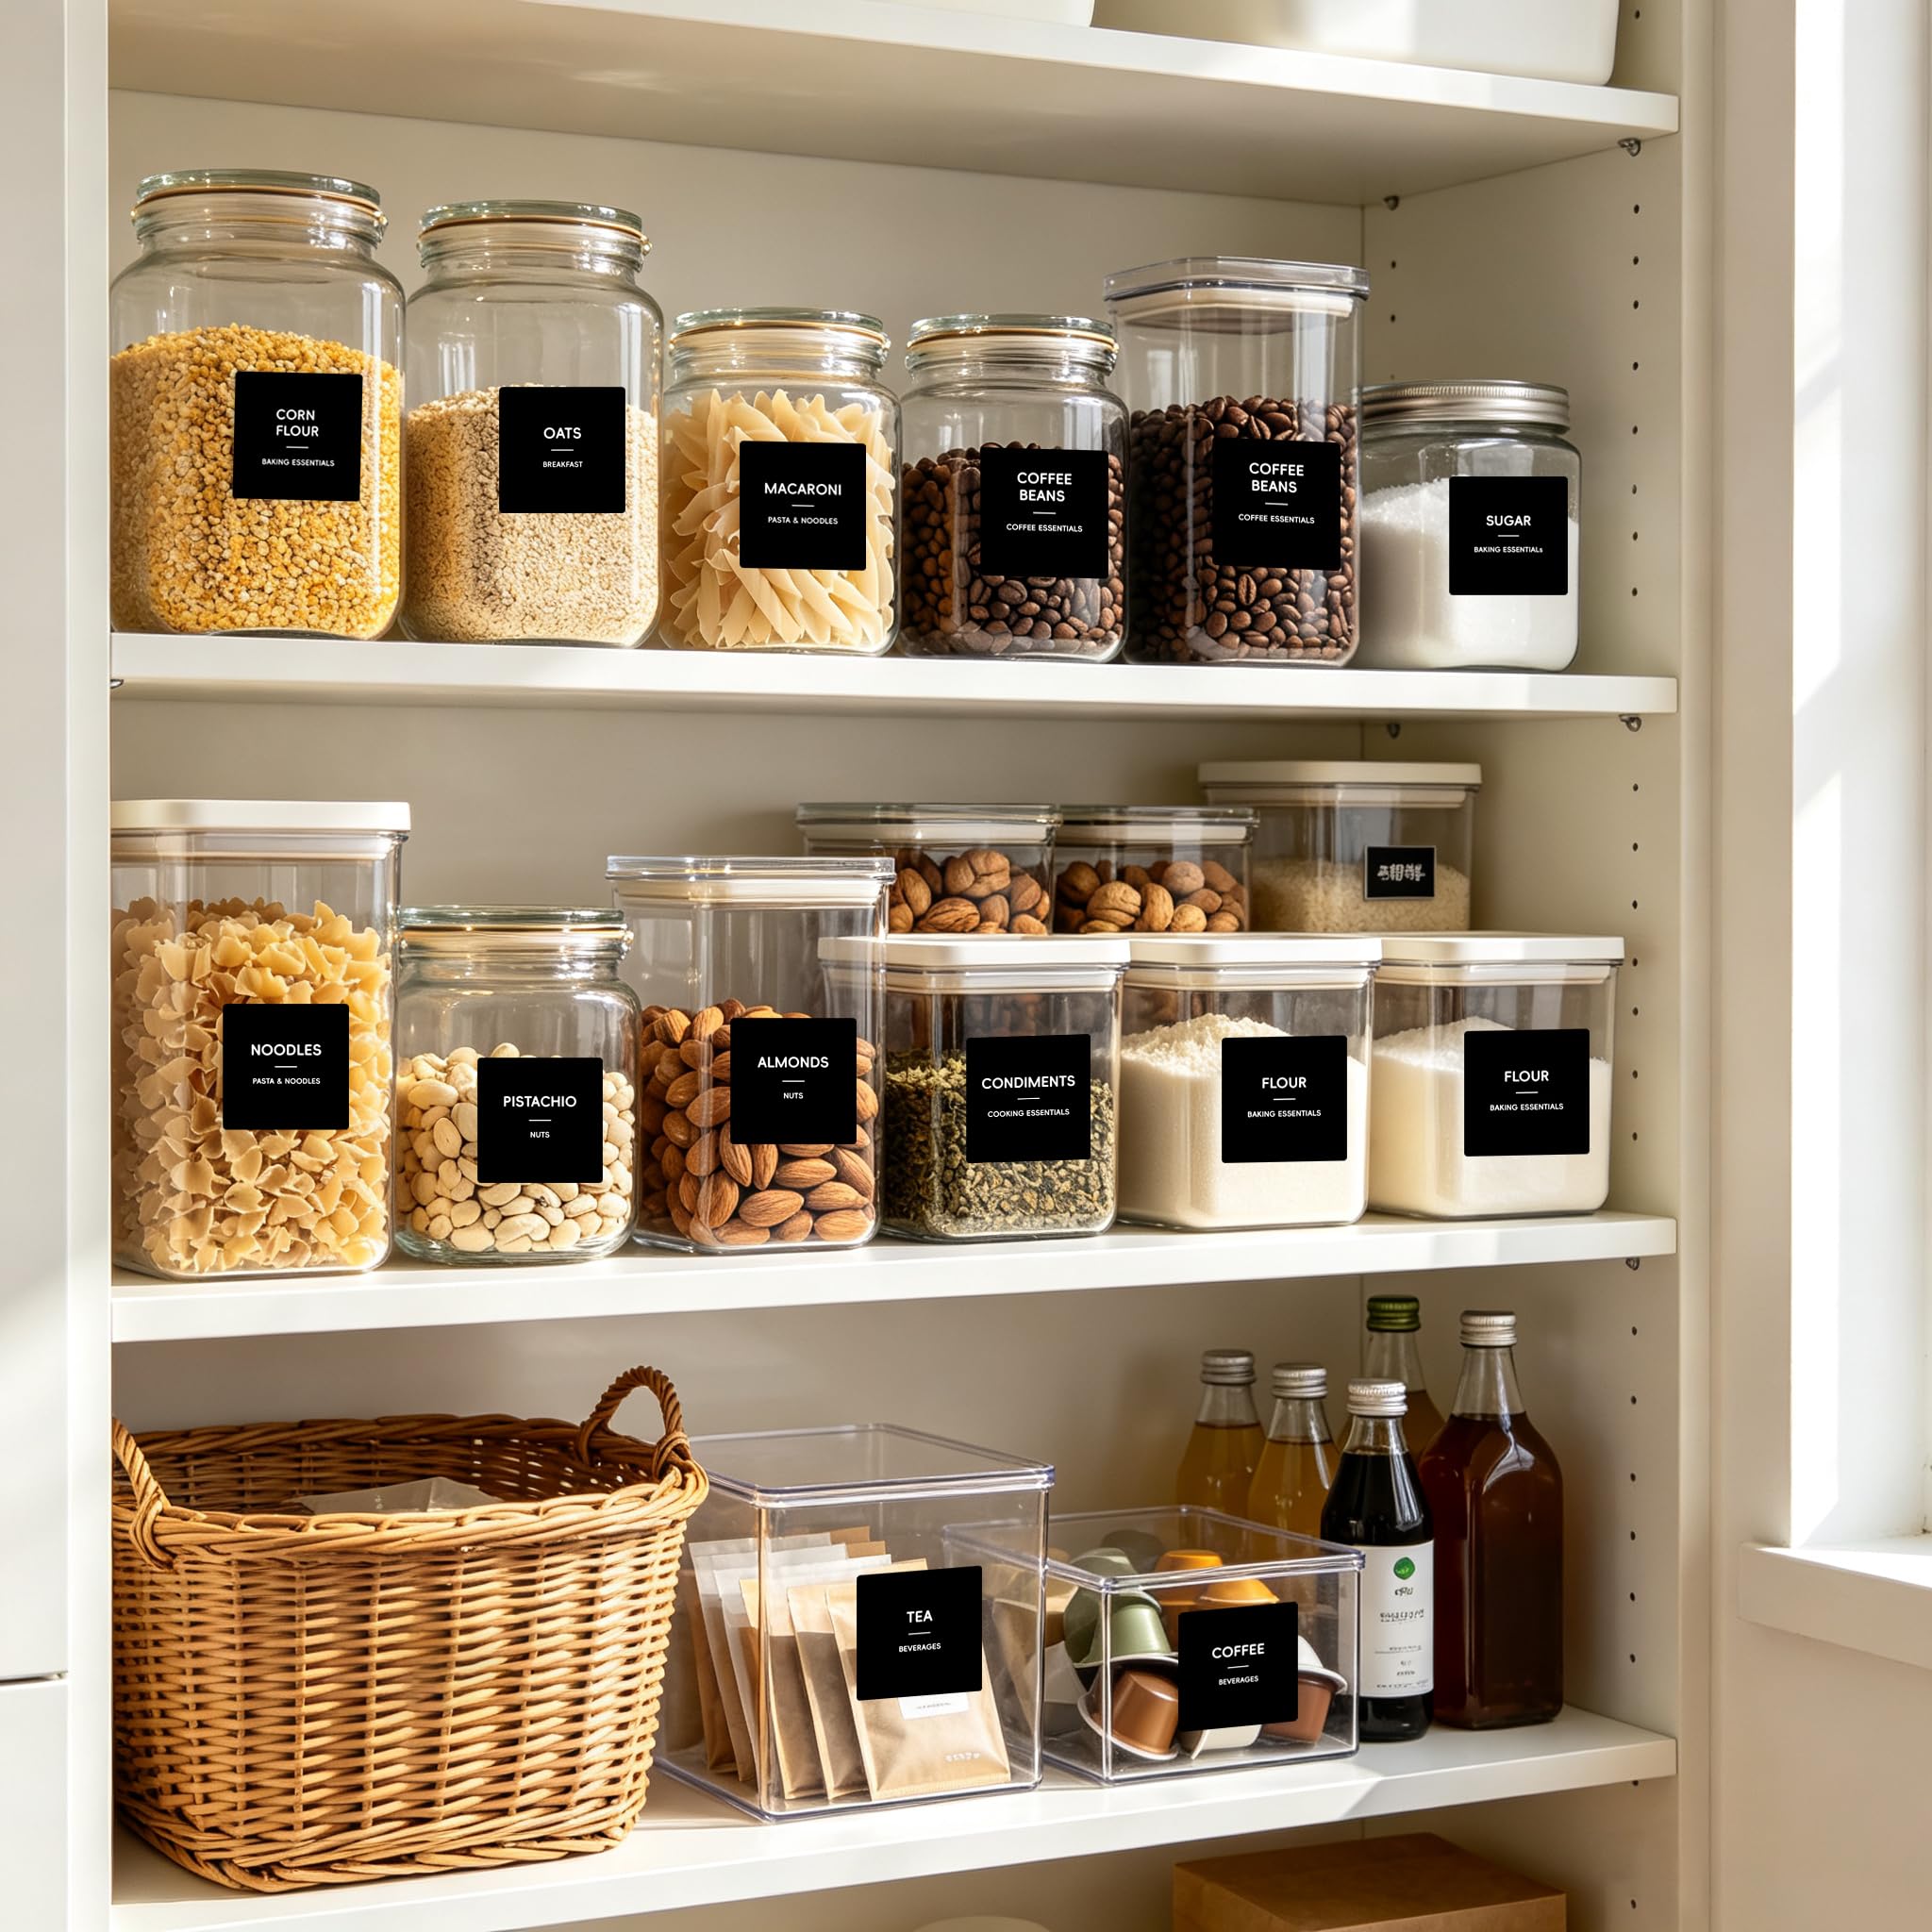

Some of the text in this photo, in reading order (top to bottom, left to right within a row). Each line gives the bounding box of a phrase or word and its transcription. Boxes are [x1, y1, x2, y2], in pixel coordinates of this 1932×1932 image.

[275, 408, 316, 422] CORN
[275, 425, 320, 438] FLOUR
[542, 426, 583, 440] OATS
[262, 458, 335, 468] BAKING ESSENTIALS
[542, 459, 584, 469] BREAKFAST
[1248, 461, 1306, 477] COFFEE
[1016, 472, 1074, 486] COFFEE
[764, 482, 842, 496] MACARONI
[1251, 479, 1299, 494] BEANS
[1019, 489, 1067, 503] BEANS
[768, 515, 839, 525] PASTA & NOODLES
[1239, 512, 1315, 525] COFFEE ESSENTIALS
[1486, 514, 1533, 527] SUGAR
[1007, 522, 1083, 534] COFFEE ESSENTIALS
[251, 1043, 323, 1058] NOODLES
[757, 1056, 830, 1070] ALMONDS
[253, 1076, 321, 1086] PASTA & NOODLES
[981, 1074, 1076, 1091] CONDIMENTS
[1261, 1076, 1308, 1090] FLOUR
[1504, 1070, 1551, 1083] FLOUR
[503, 1094, 578, 1108] PISTACHIO
[783, 1091, 805, 1101] NUTS
[988, 1108, 1070, 1119] COOKING ESSENTIALS
[1248, 1108, 1322, 1119] BAKING ESSENTIALS
[1491, 1102, 1564, 1112] BAKING ESSENTIALS
[529, 1130, 552, 1140] NUTS
[906, 1609, 934, 1624] TEA
[898, 1642, 942, 1654] BEVERAGES
[1211, 1642, 1266, 1659] COFFEE
[1218, 1674, 1260, 1686] BEVERAGES
